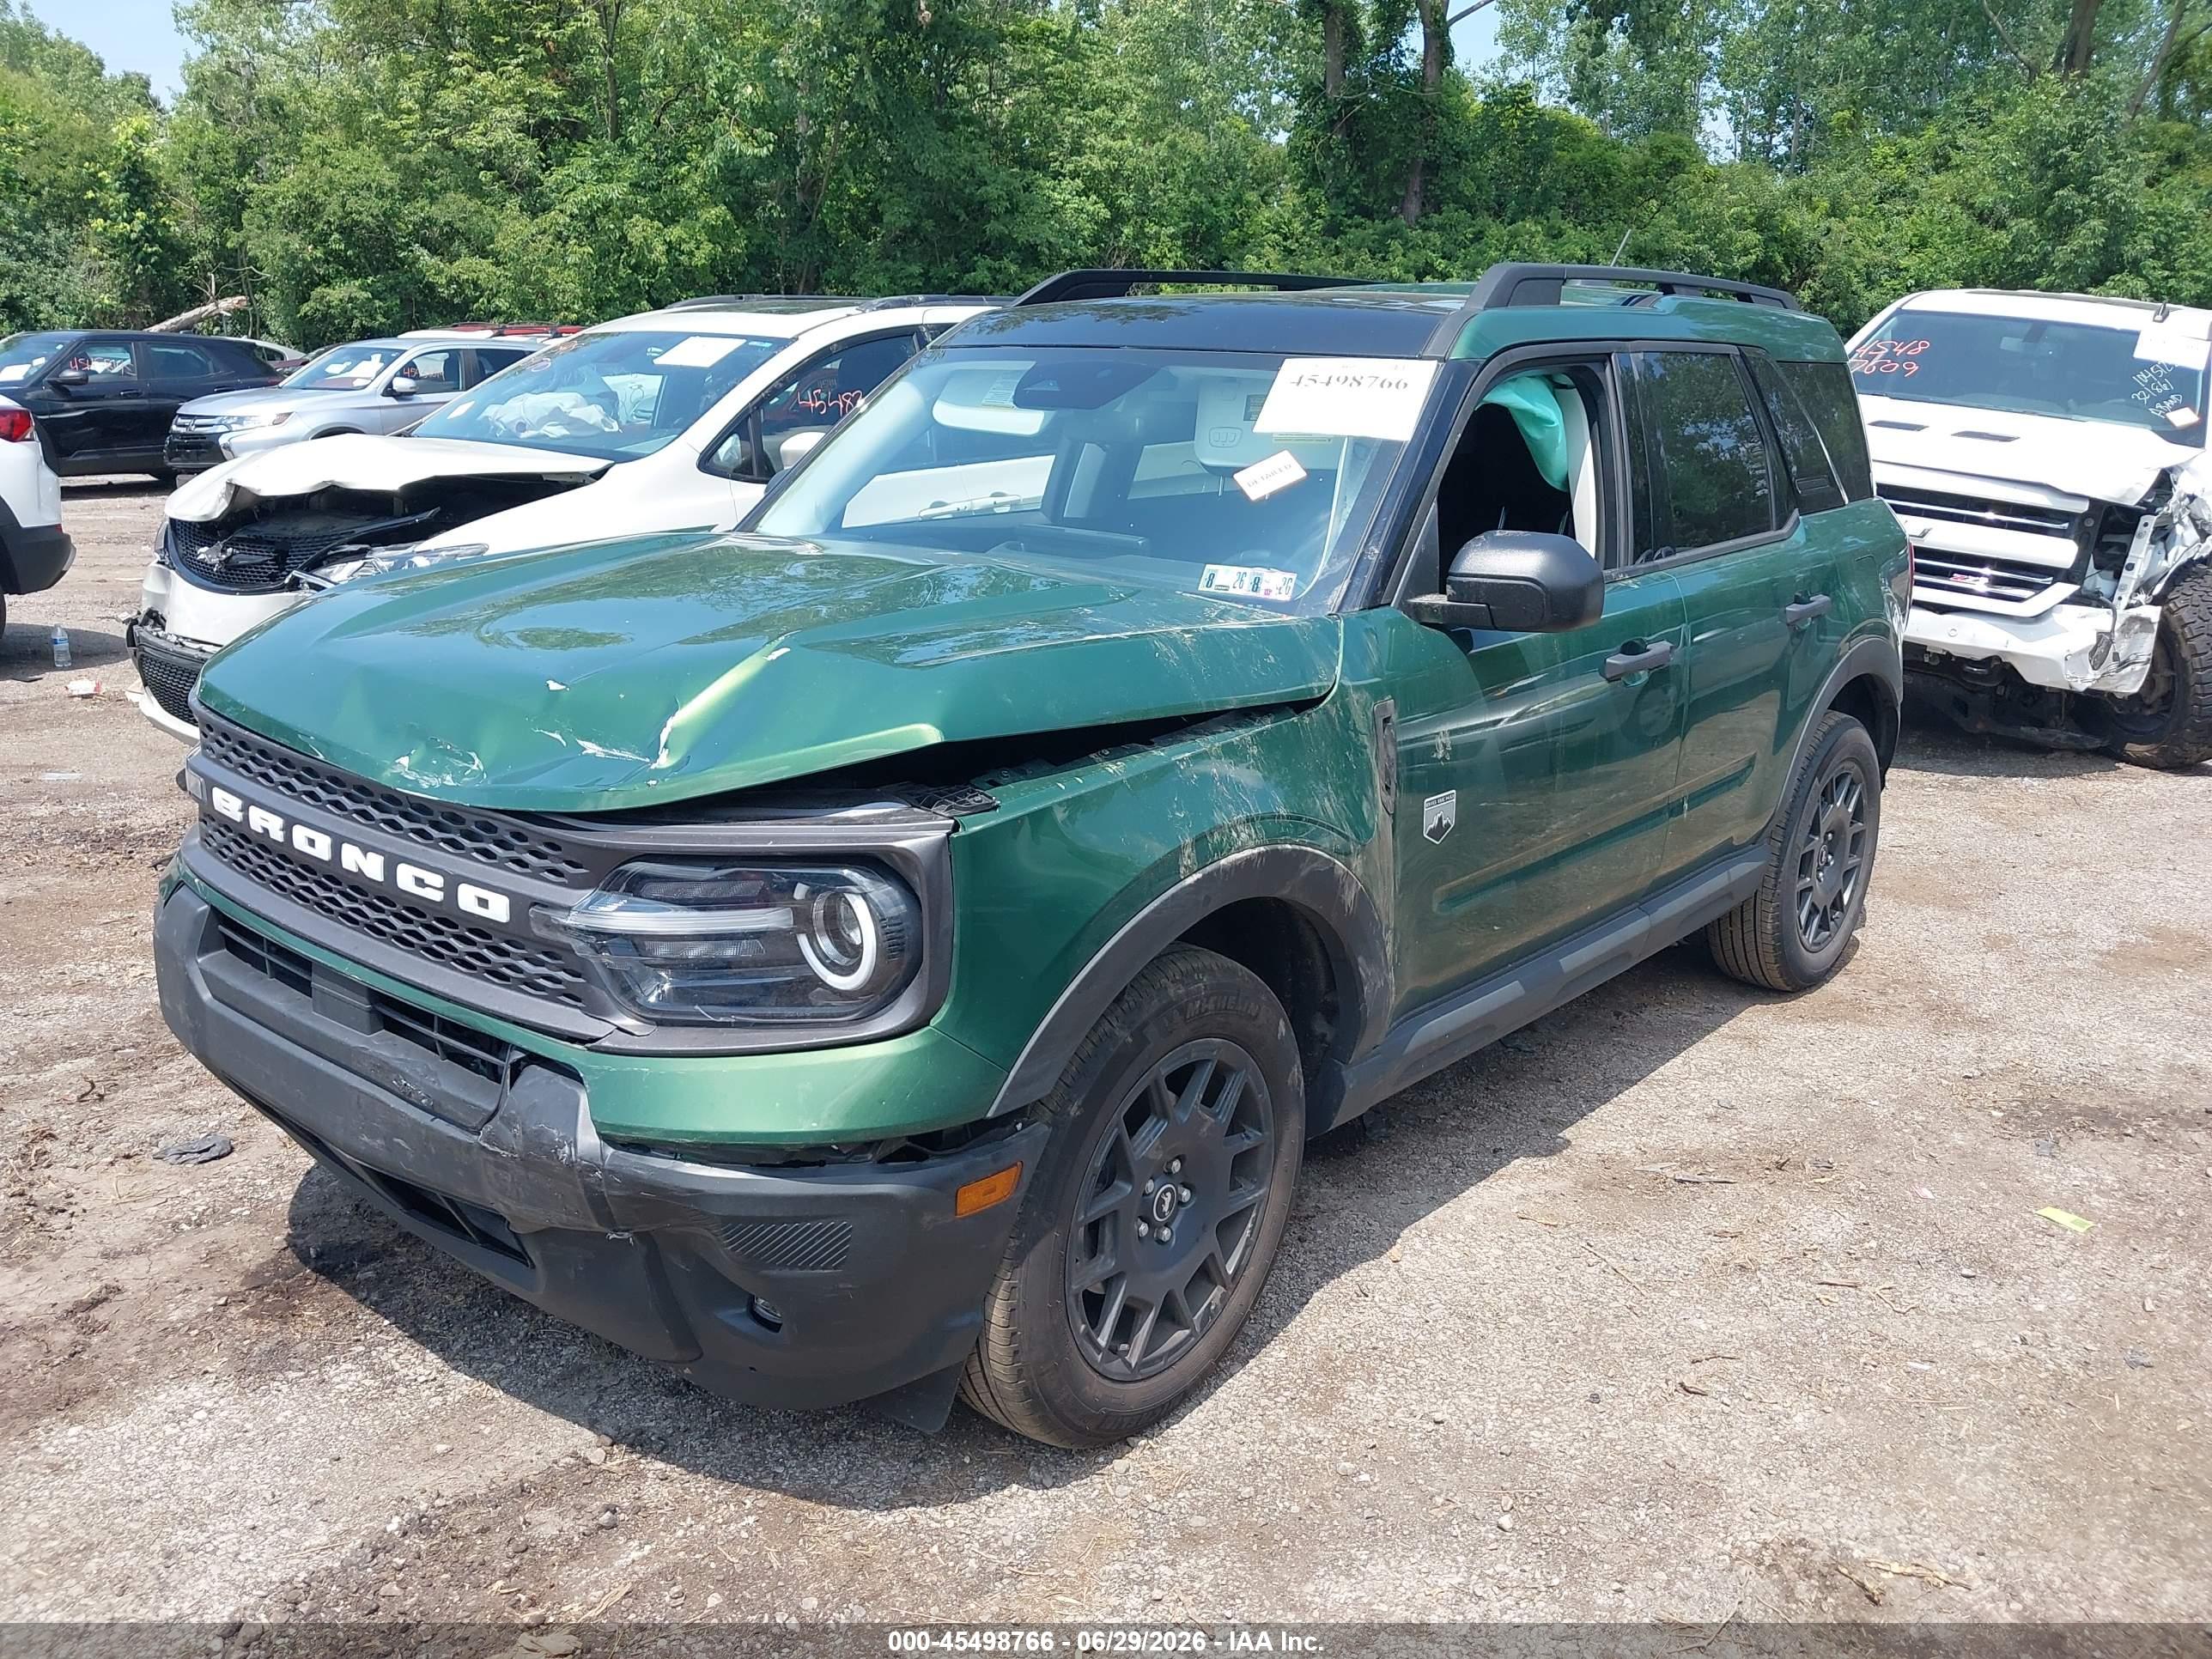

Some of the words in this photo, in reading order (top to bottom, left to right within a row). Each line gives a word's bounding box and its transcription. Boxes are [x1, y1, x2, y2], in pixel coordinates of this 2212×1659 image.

[1855, 339, 1930, 358] 4548
[1290, 374, 1408, 389] 45498766
[212, 787, 511, 923] BRONCO
